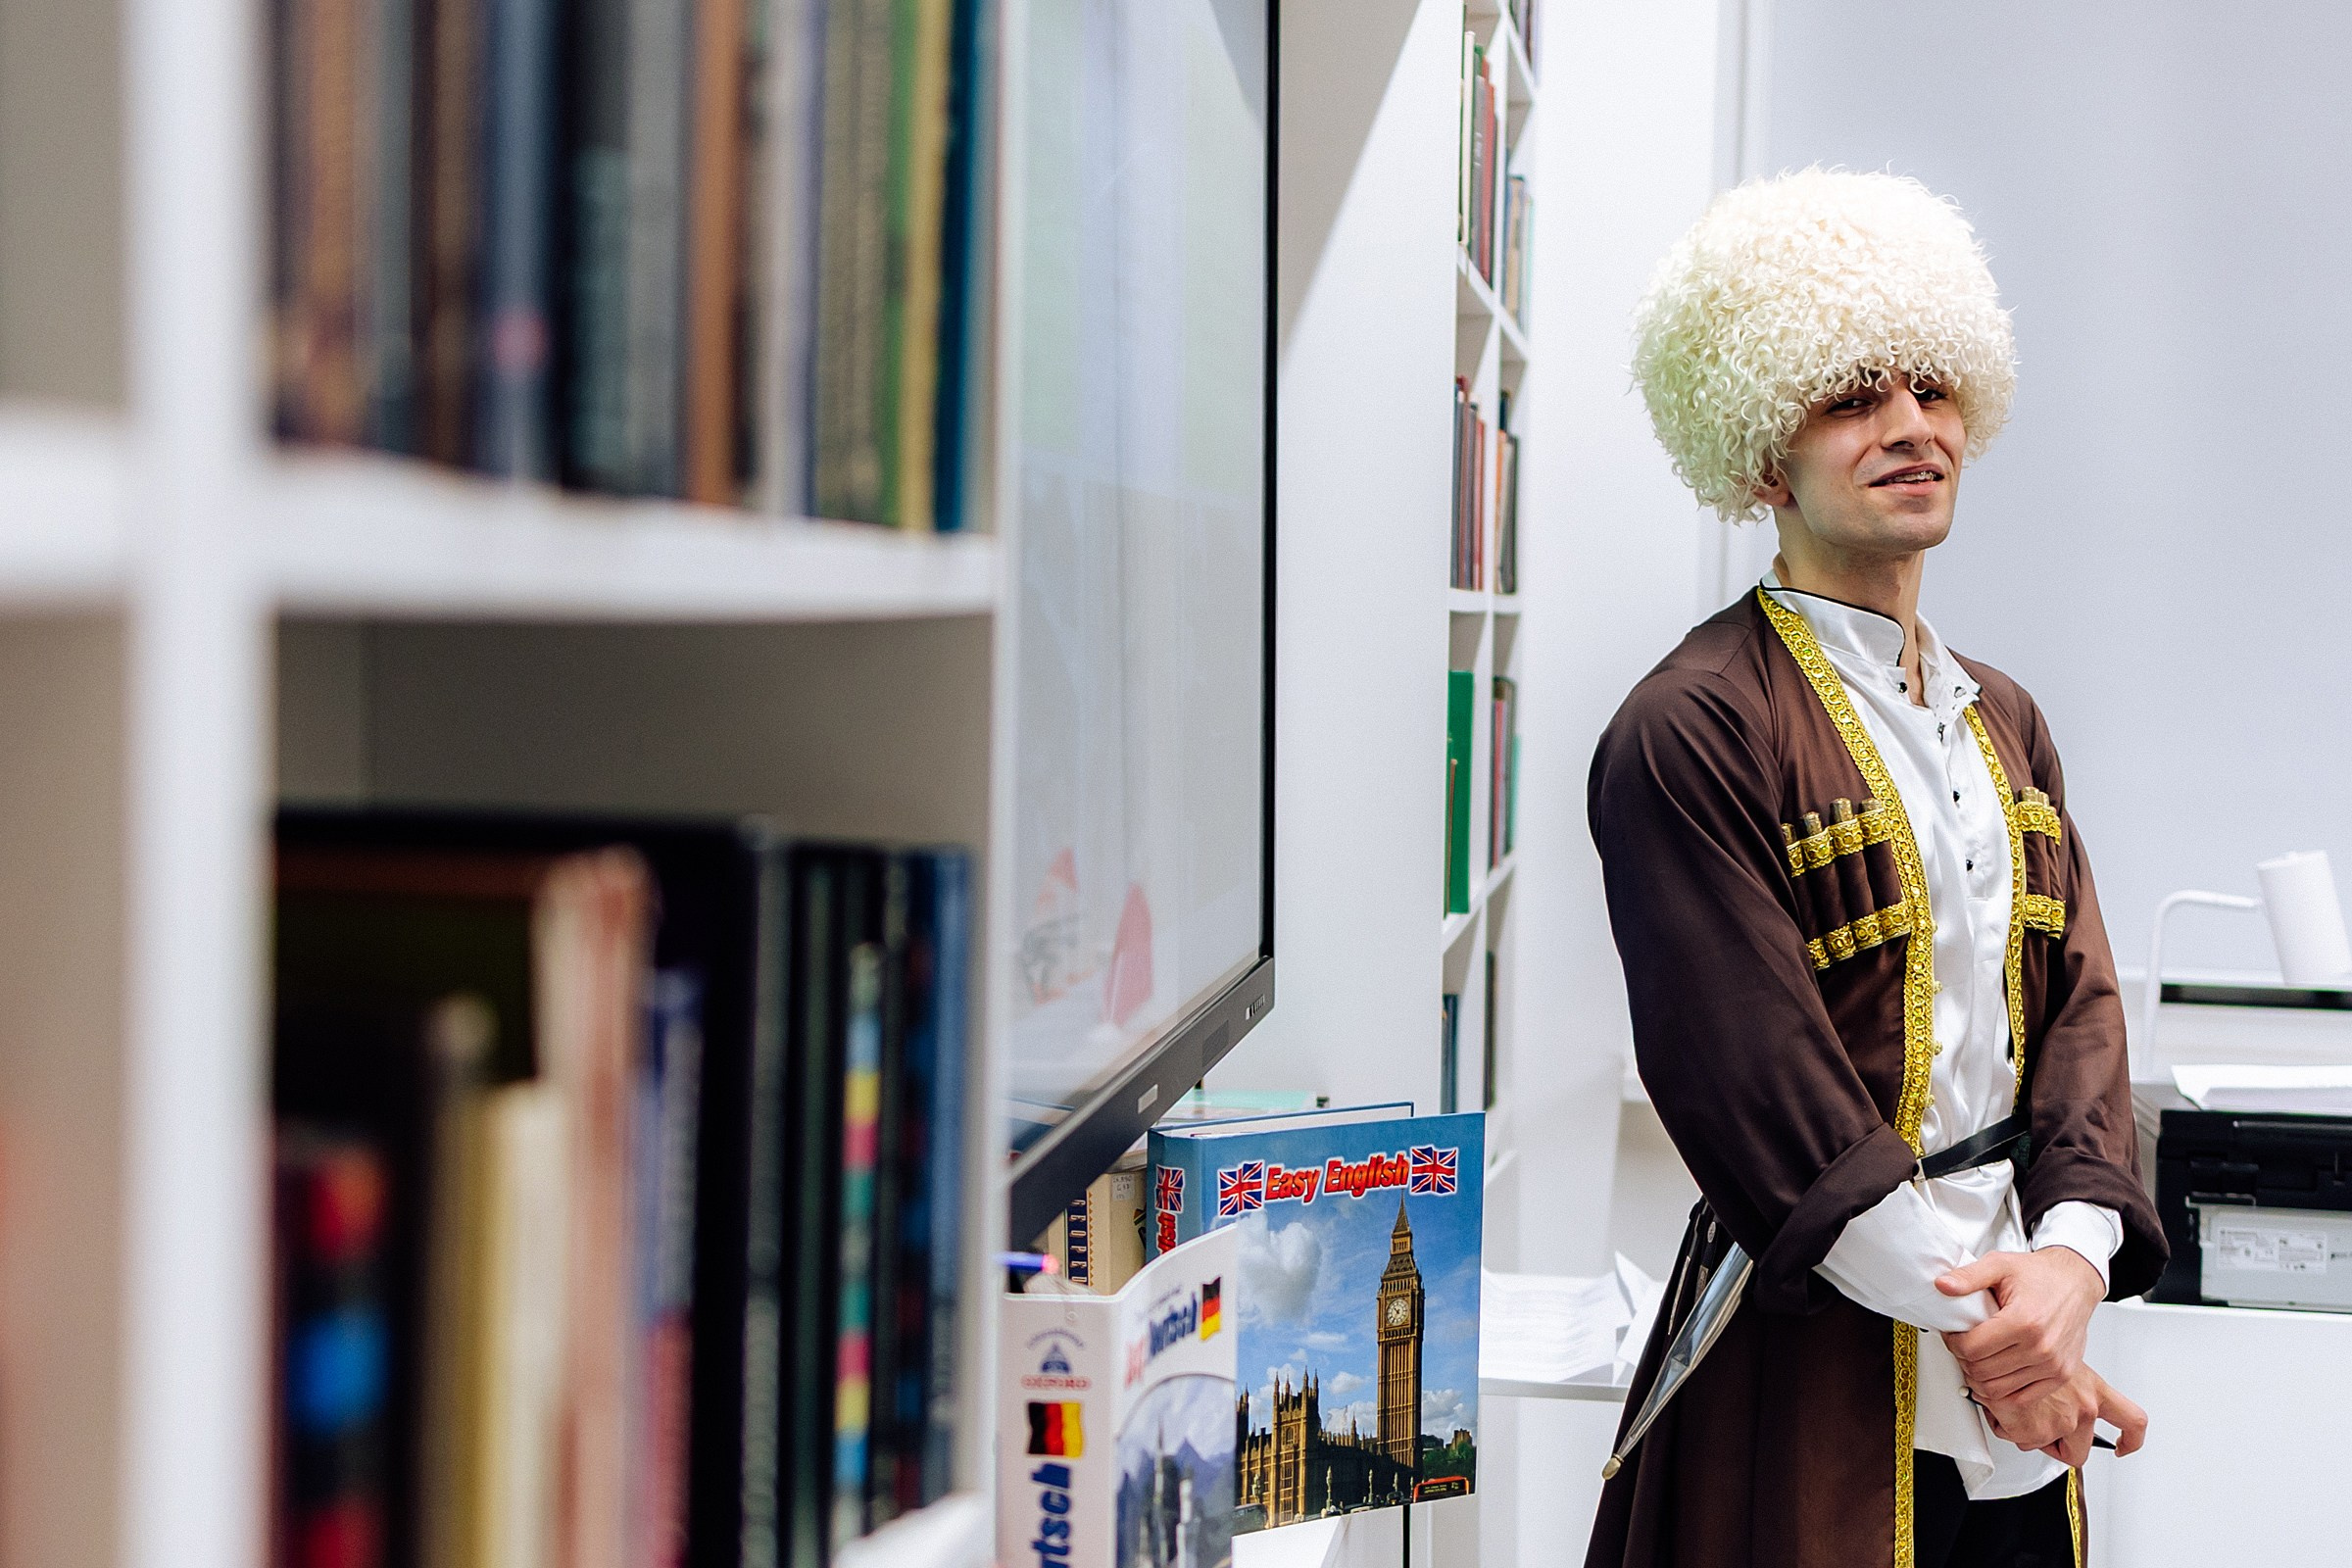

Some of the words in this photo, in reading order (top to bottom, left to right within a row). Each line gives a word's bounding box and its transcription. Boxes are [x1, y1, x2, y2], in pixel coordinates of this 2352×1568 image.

[1264, 1165, 1322, 1203] Easy
[1324, 1152, 1410, 1199] English
[1156, 1211, 1176, 1254] lish
